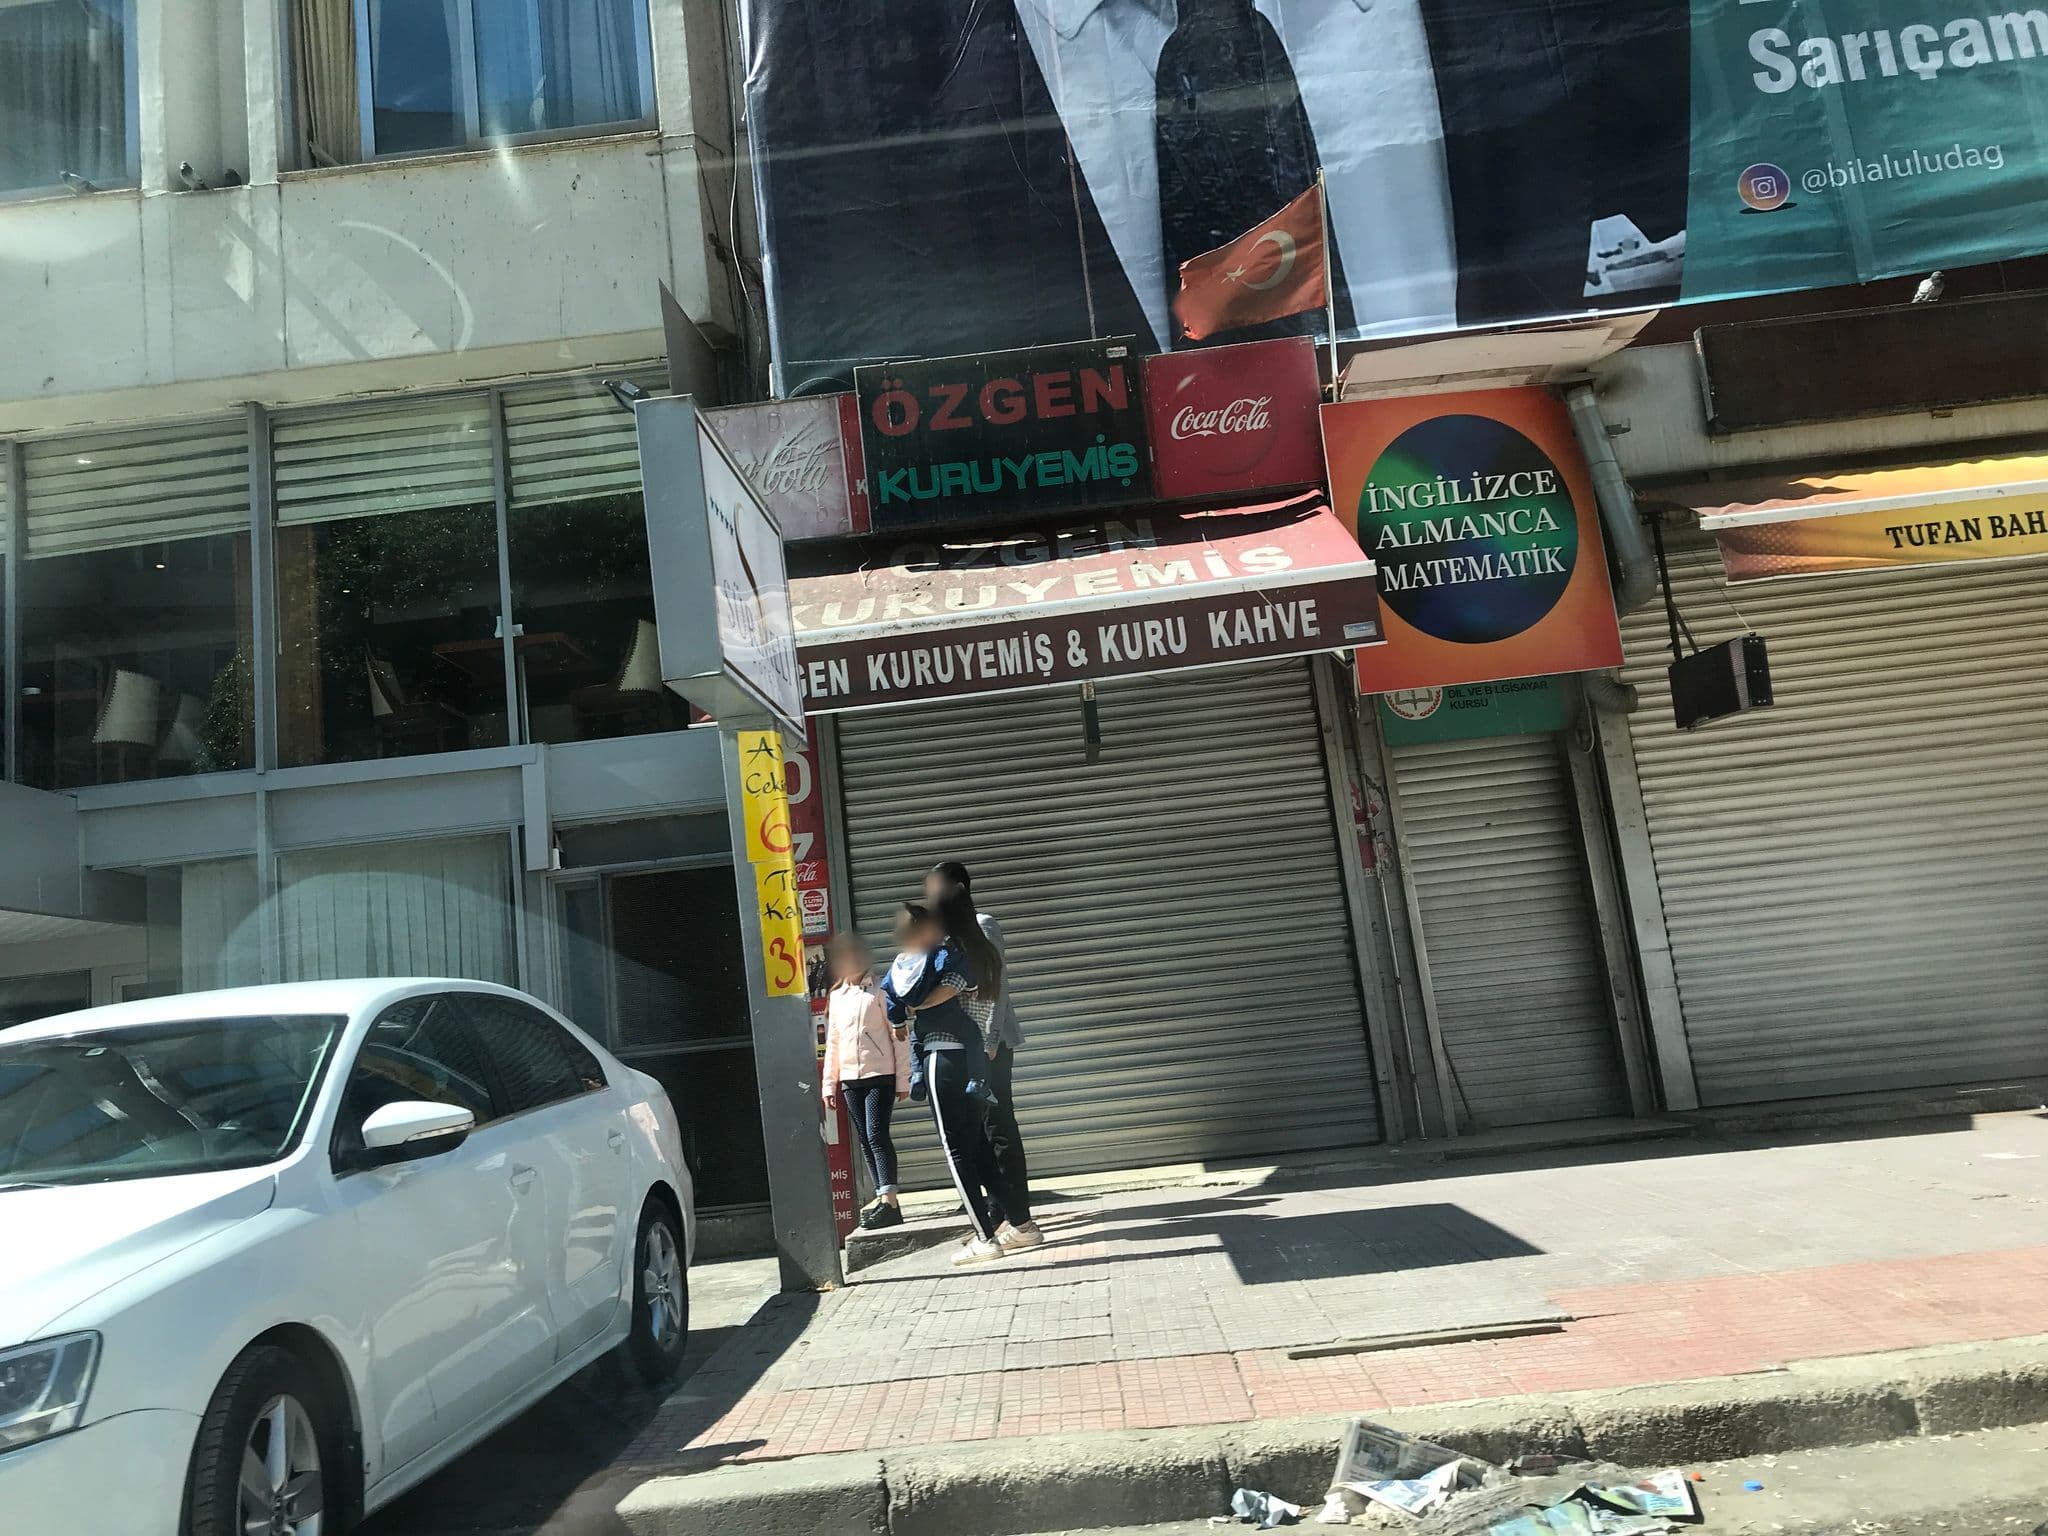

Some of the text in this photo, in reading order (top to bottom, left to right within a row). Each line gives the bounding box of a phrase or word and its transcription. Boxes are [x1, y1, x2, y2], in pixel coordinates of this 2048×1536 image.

[1747, 9, 2048, 94] Sarıçam
[1802, 144, 2004, 194] @bilaluludag
[872, 364, 1130, 437] ÖZGEN
[1171, 396, 1273, 440] Coca-Cola
[878, 433, 1139, 504] KURUYEMİŞ
[1365, 469, 1558, 514] İNGİLİZCE
[1375, 507, 1561, 550] ALMANCA
[1885, 517, 1983, 549] TUFAN
[1381, 542, 1567, 592] MATEMATİK
[867, 631, 1055, 691] KURUYEMİŞ
[1066, 629, 1088, 668] &
[1097, 616, 1189, 663] KURU
[1207, 598, 1321, 649] KAHVE
[1450, 698, 1489, 710] KURSU
[1467, 686, 1482, 696] VE
